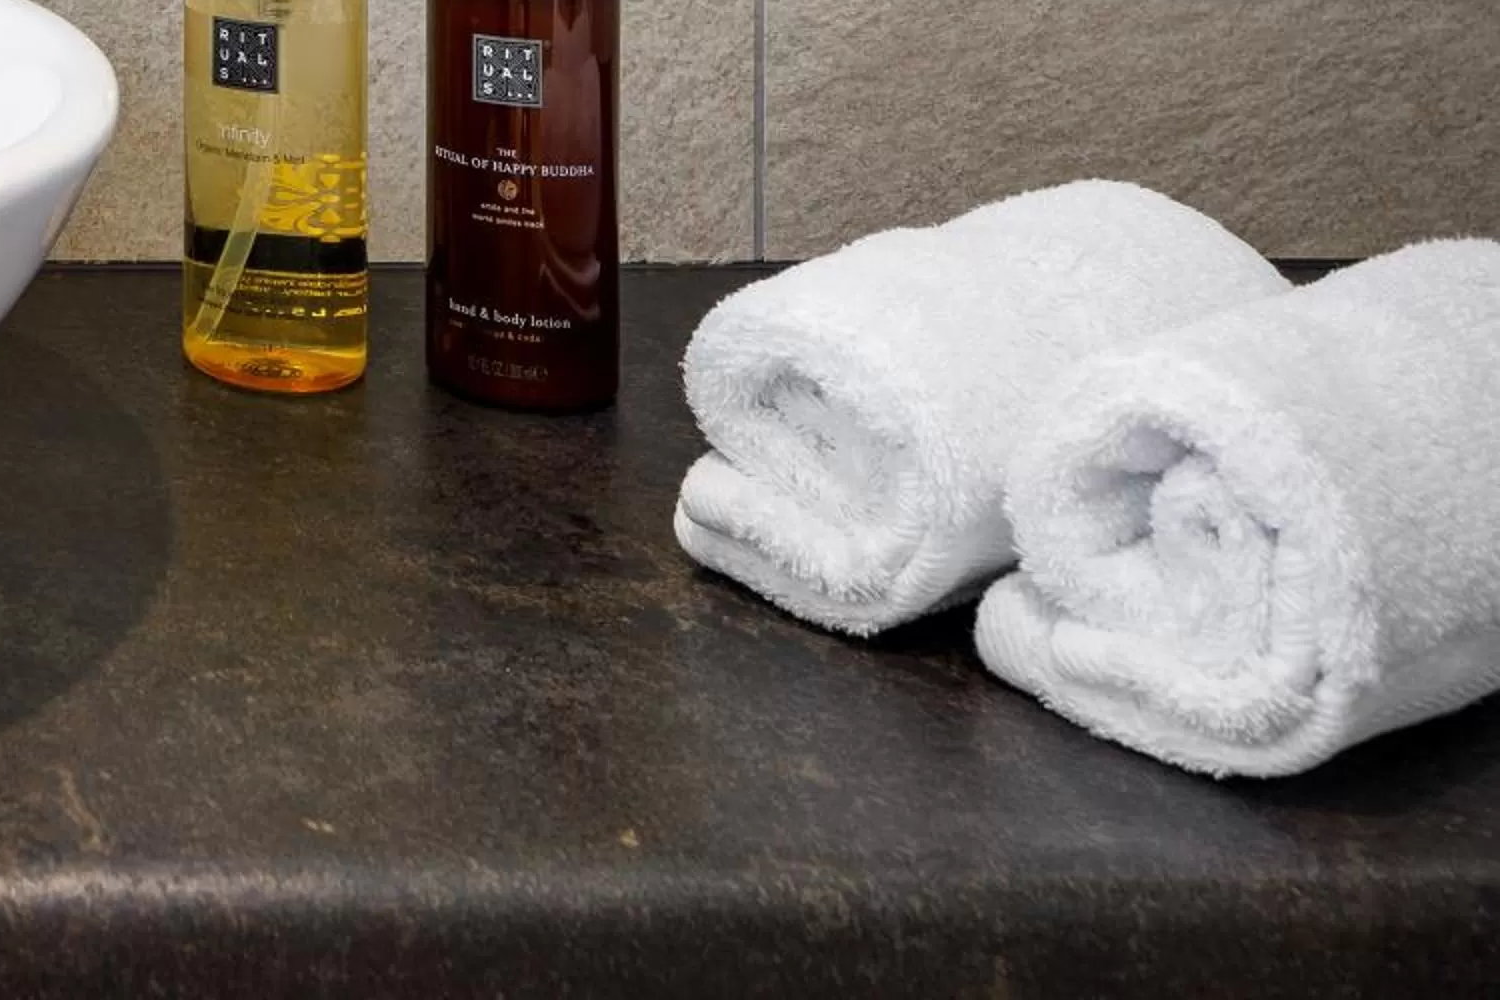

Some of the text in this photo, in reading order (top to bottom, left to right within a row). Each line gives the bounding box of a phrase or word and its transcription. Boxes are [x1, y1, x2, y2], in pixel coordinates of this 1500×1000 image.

[496, 147, 518, 158] THE
[471, 157, 490, 170] OF
[493, 160, 538, 176] HAPPY
[479, 306, 490, 321] &
[493, 308, 528, 329] body
[531, 315, 571, 329] lotion
